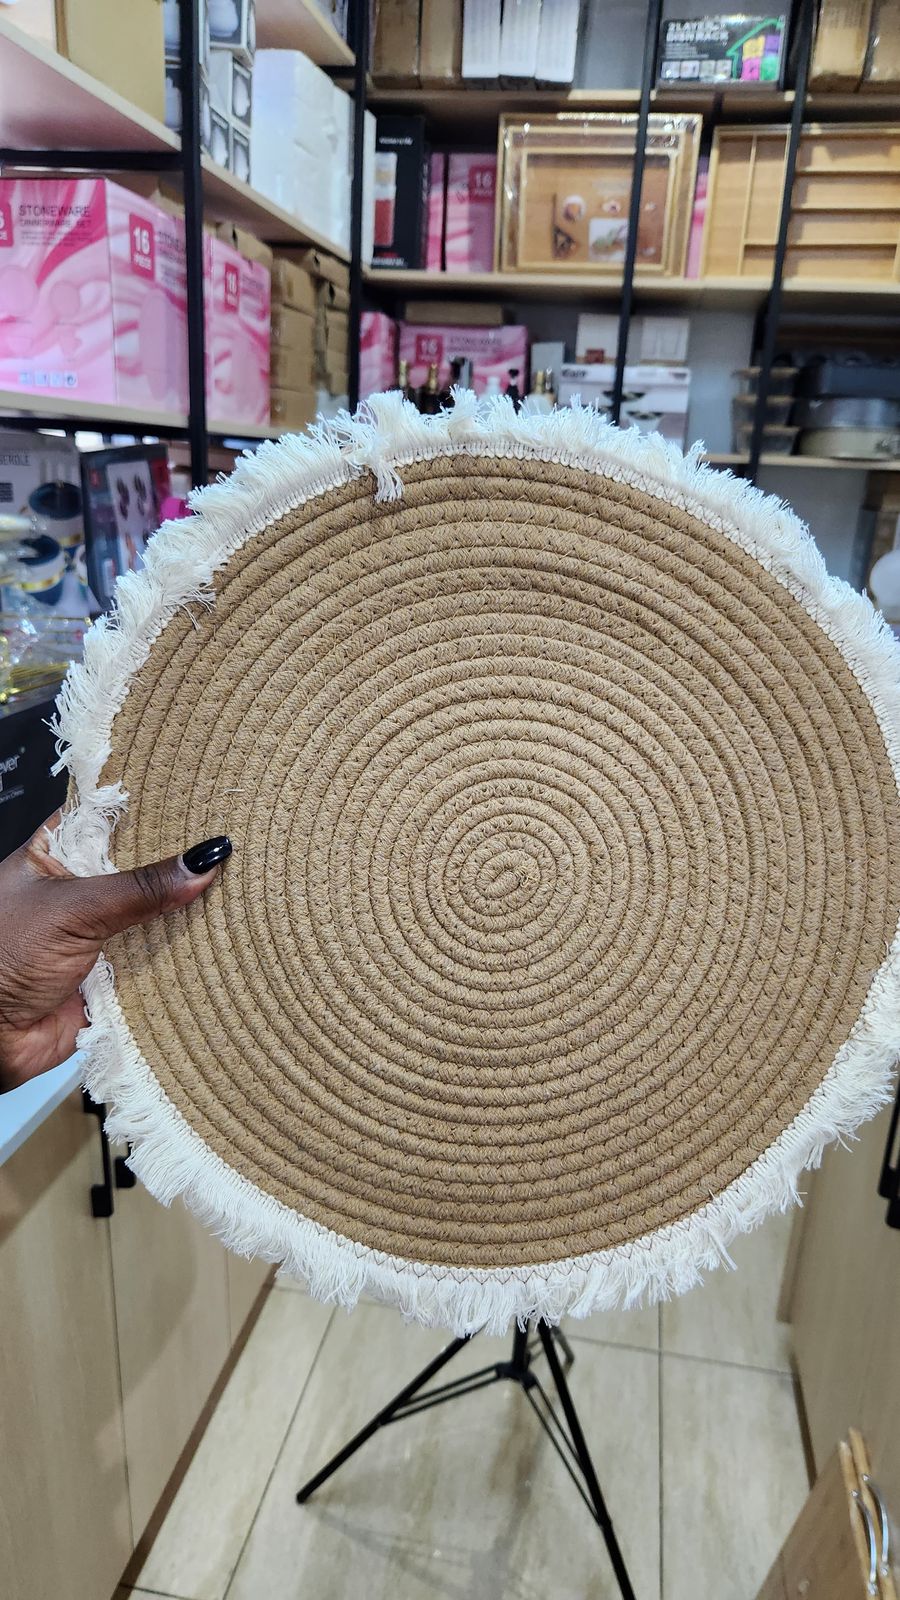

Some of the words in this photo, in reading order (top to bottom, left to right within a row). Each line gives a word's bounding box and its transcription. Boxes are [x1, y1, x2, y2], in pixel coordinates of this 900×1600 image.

[475, 171, 493, 189] 16
[19, 205, 91, 217] STONEWARE
[133, 226, 151, 256] 16
[421, 339, 438, 355] 16
